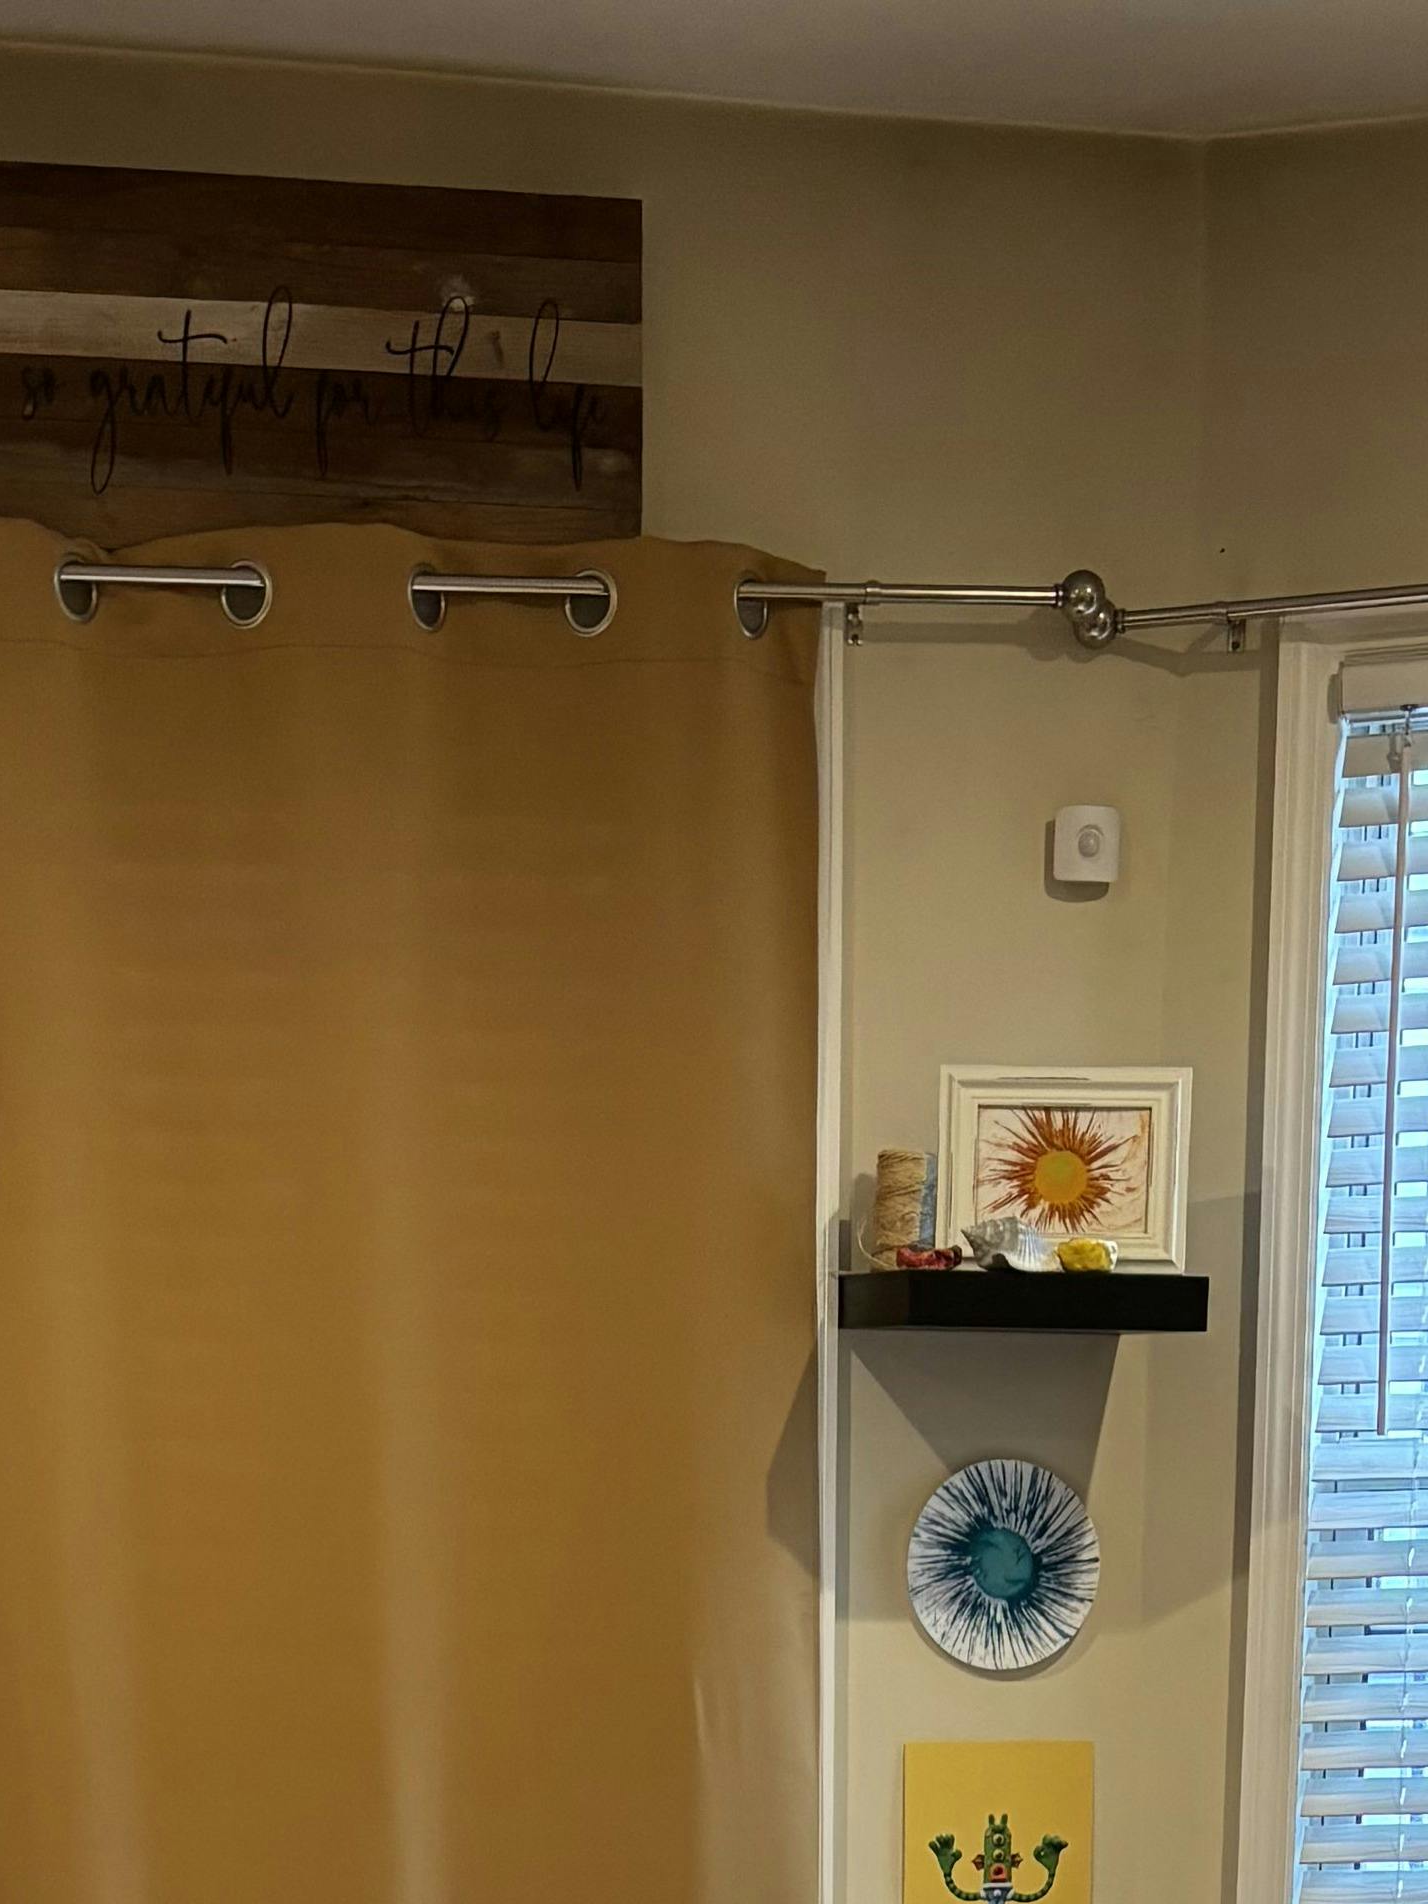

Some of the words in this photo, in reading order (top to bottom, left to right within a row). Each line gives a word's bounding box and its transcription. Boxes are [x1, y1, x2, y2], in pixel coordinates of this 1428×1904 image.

[90, 285, 295, 494] grateful
[315, 366, 377, 478] for
[385, 295, 504, 442] this
[528, 299, 609, 492] life
